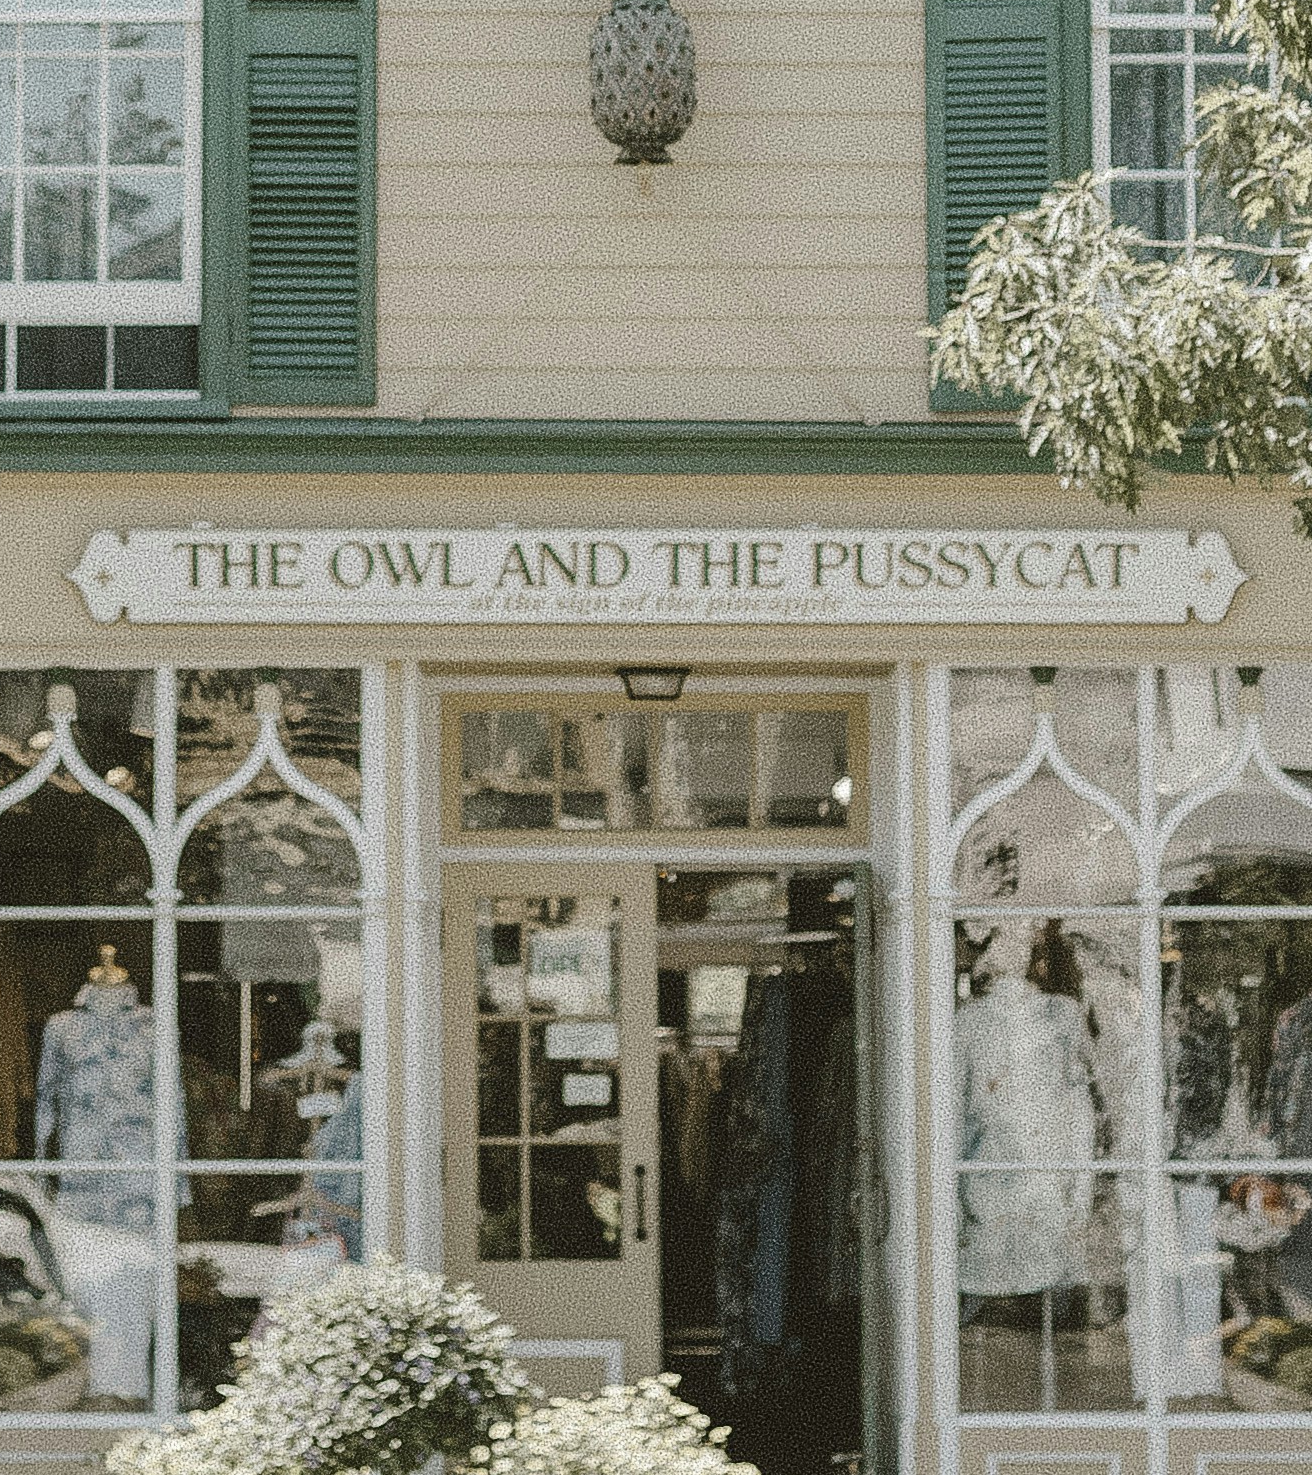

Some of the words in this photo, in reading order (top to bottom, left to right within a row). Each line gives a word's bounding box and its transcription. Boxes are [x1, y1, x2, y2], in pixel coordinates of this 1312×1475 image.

[172, 539, 306, 590] THE
[327, 539, 476, 590] OWL
[494, 539, 632, 590] AND
[652, 539, 786, 590] THE
[810, 539, 1143, 590] PUSSYCAT
[467, 594, 496, 612] at
[501, 592, 548, 613] the
[553, 593, 611, 617] sign
[619, 591, 651, 613] of
[652, 592, 698, 613] the
